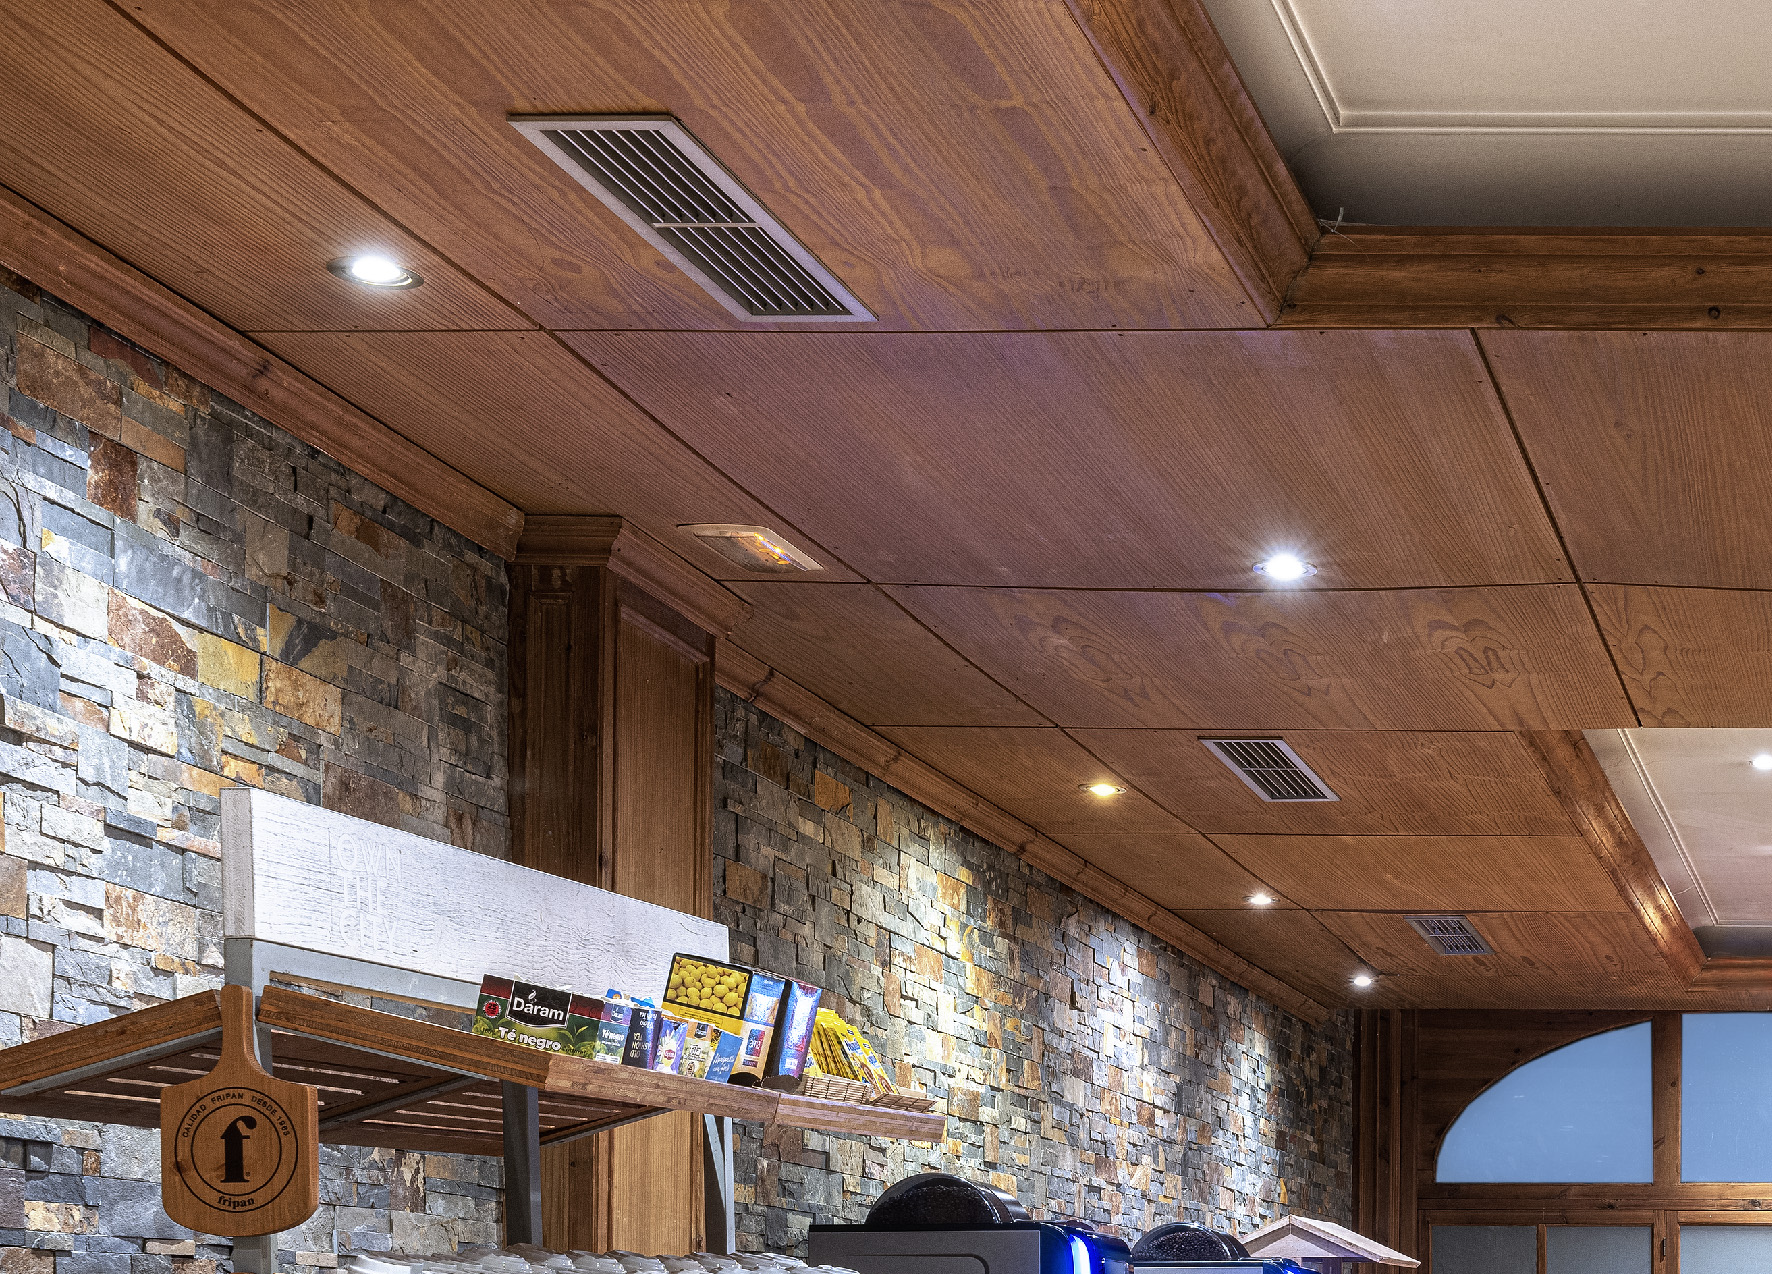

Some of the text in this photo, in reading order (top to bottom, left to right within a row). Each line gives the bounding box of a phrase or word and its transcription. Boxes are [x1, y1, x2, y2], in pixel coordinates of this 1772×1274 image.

[336, 833, 402, 882] OWN
[339, 908, 398, 952] CITY
[512, 996, 564, 1021] Daram
[498, 1026, 517, 1041] Té
[519, 1033, 562, 1051] negro
[182, 1104, 207, 1138] CALIDAD
[210, 1092, 244, 1105] FRIPAN
[251, 1095, 277, 1116] DESDE
[220, 1115, 257, 1183] f
[217, 1196, 255, 1210] fripan
